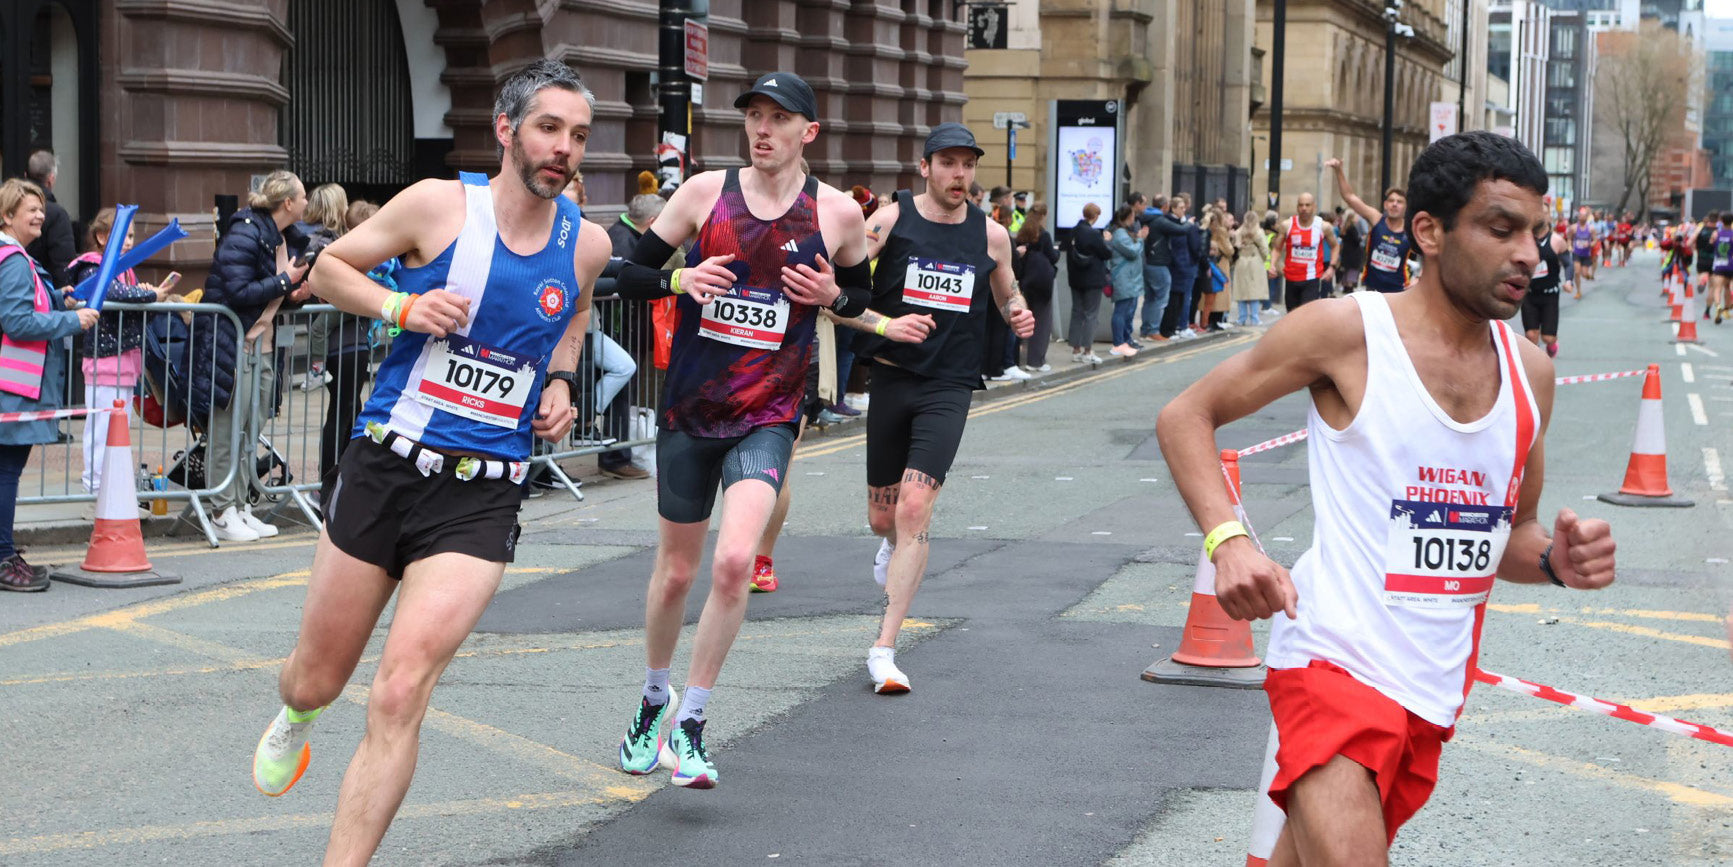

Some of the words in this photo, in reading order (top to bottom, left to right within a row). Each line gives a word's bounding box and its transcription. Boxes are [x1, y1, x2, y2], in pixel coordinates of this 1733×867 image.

[1077, 116, 1096, 126] global
[558, 215, 572, 248] soar
[918, 273, 962, 293] 10143
[928, 294, 947, 302] AARON
[714, 299, 776, 328] 10338
[730, 326, 754, 337] KIERAN
[445, 359, 515, 399] 10179
[461, 395, 486, 409] RICKS
[1418, 466, 1486, 487] WIGAN
[1406, 486, 1491, 506] PHOENIX
[1413, 536, 1491, 572] 10138
[1444, 580, 1460, 591] MO
